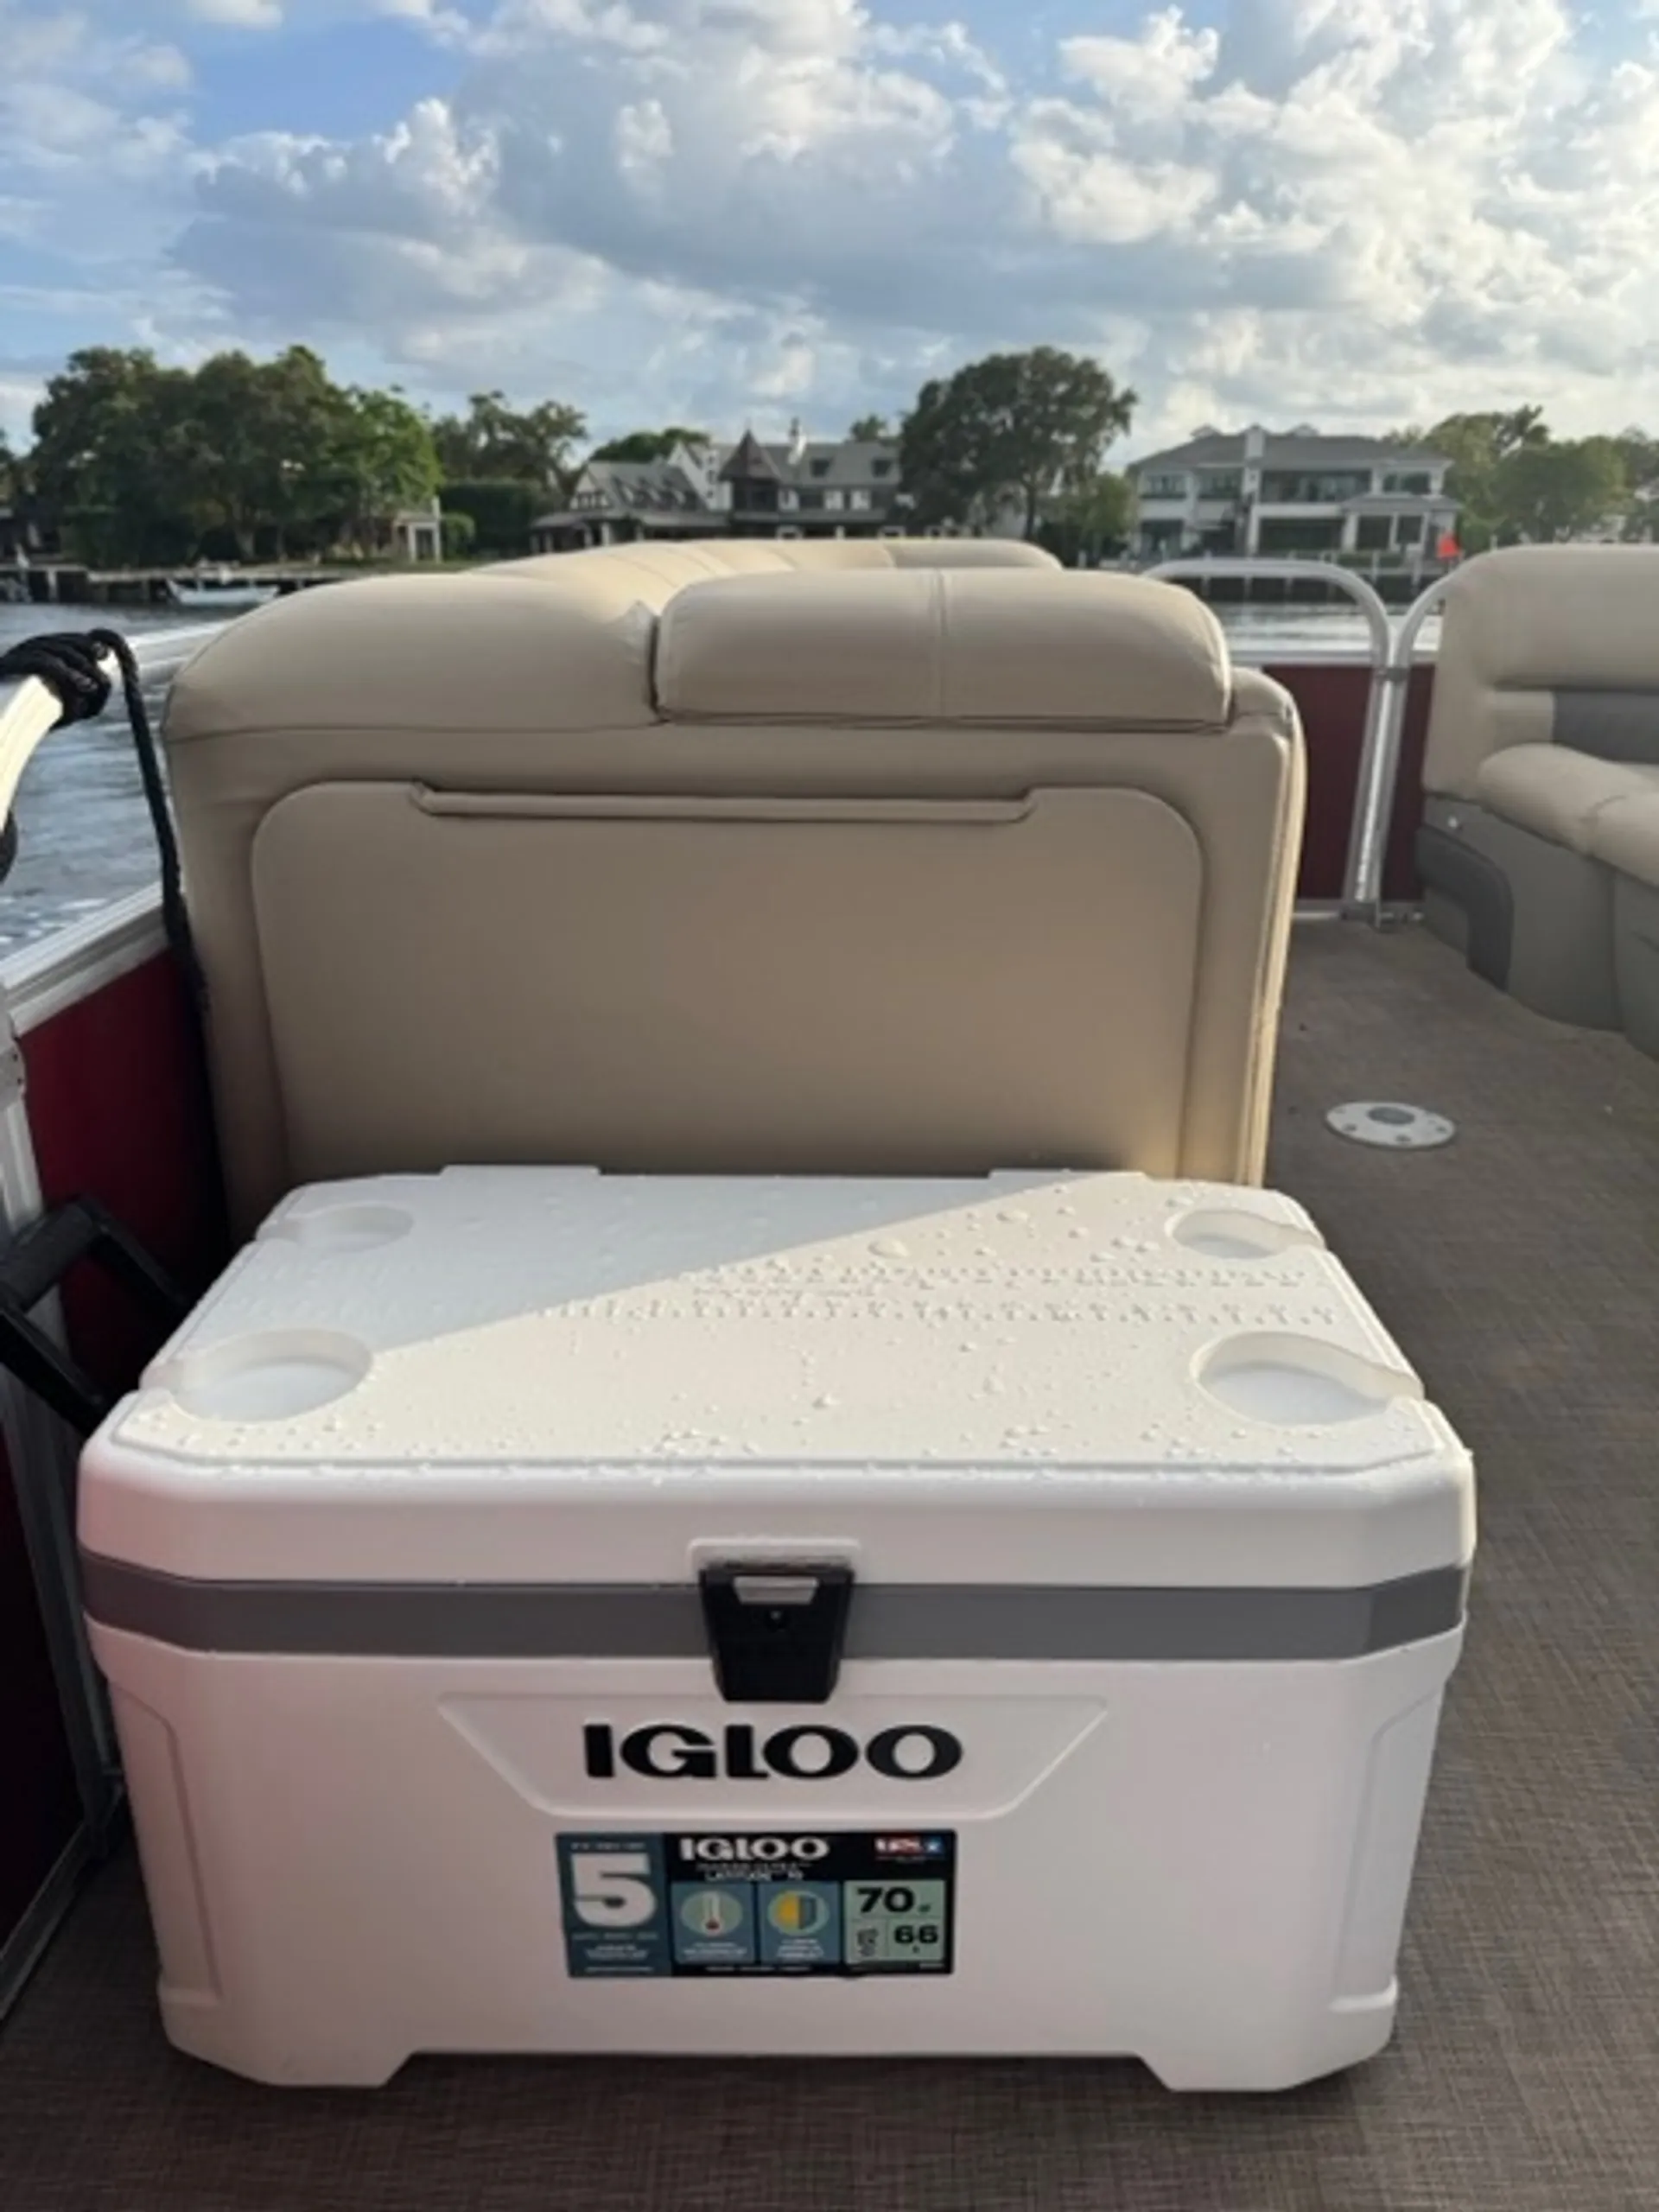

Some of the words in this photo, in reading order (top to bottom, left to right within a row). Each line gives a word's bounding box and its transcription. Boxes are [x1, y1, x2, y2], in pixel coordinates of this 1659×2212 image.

[583, 1724, 963, 1780] IGLOO
[679, 1836, 829, 1860] IGLOO
[571, 1853, 657, 1926] 5
[856, 1886, 914, 1913] 70
[894, 1925, 939, 1944] 66
